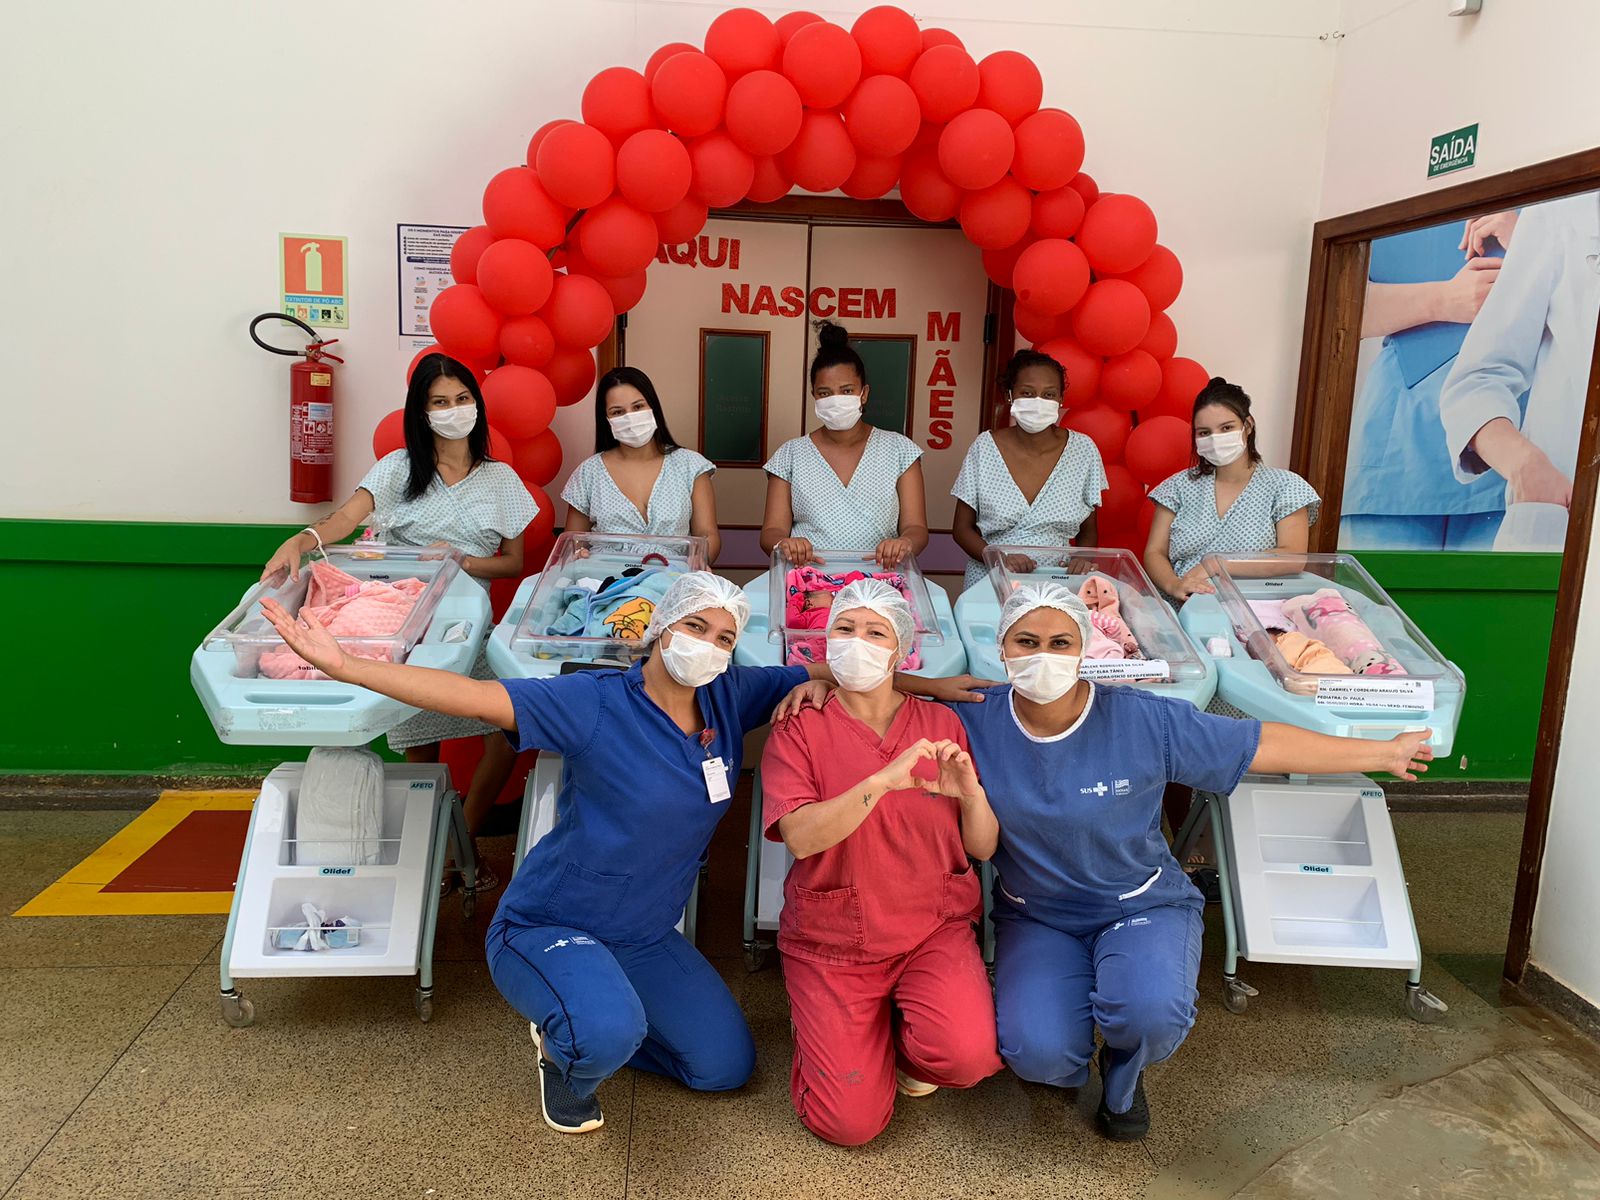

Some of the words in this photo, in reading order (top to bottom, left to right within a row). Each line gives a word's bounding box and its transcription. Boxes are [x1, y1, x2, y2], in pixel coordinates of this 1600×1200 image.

[1430, 135, 1474, 165] SAÍDA
[721, 282, 897, 319] NASCEM
[926, 311, 961, 450] MÃES
[1302, 865, 1329, 873] Olidef
